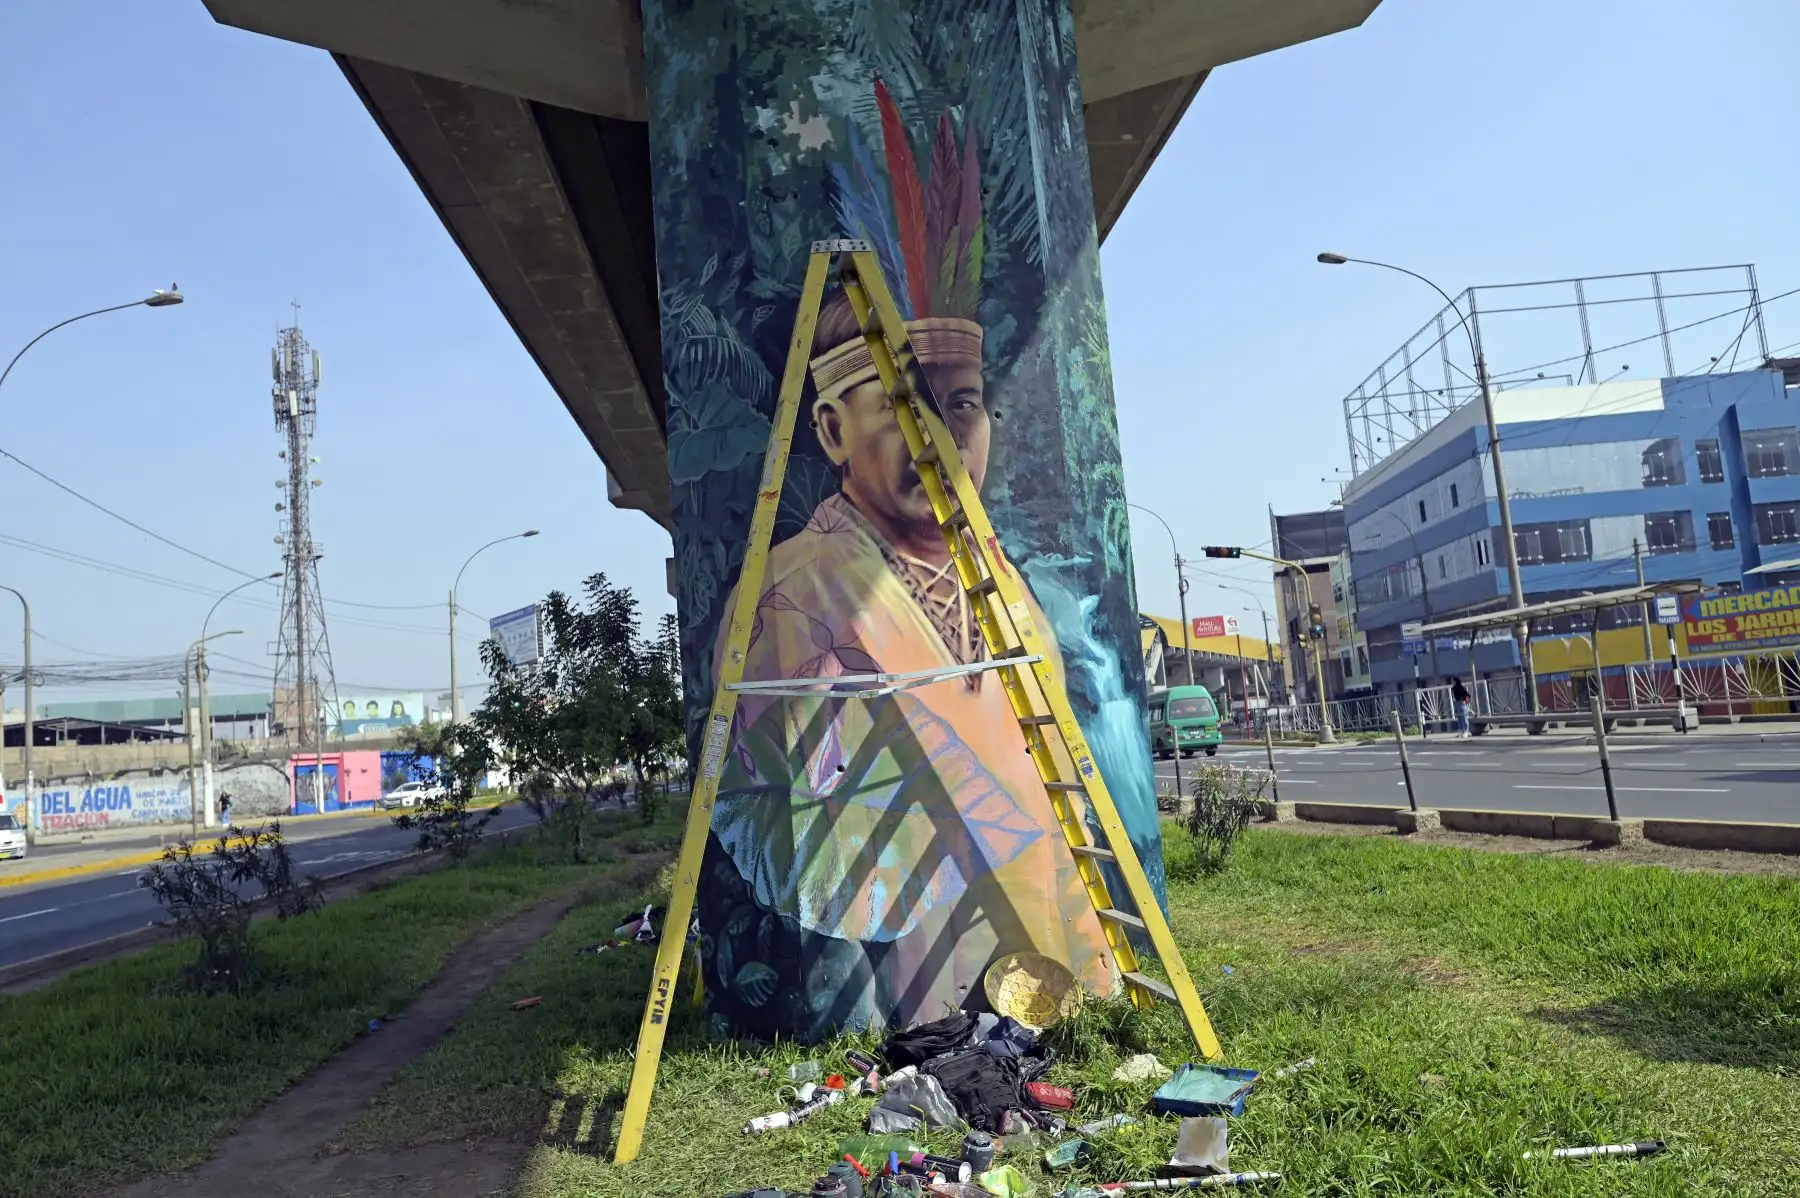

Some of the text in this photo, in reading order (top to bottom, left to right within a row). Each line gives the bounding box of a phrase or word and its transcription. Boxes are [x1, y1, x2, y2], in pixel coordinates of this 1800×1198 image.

[1687, 619, 1727, 637] LOS
[1712, 632, 1737, 643] DE
[41, 786, 132, 815] DEL AGUA
